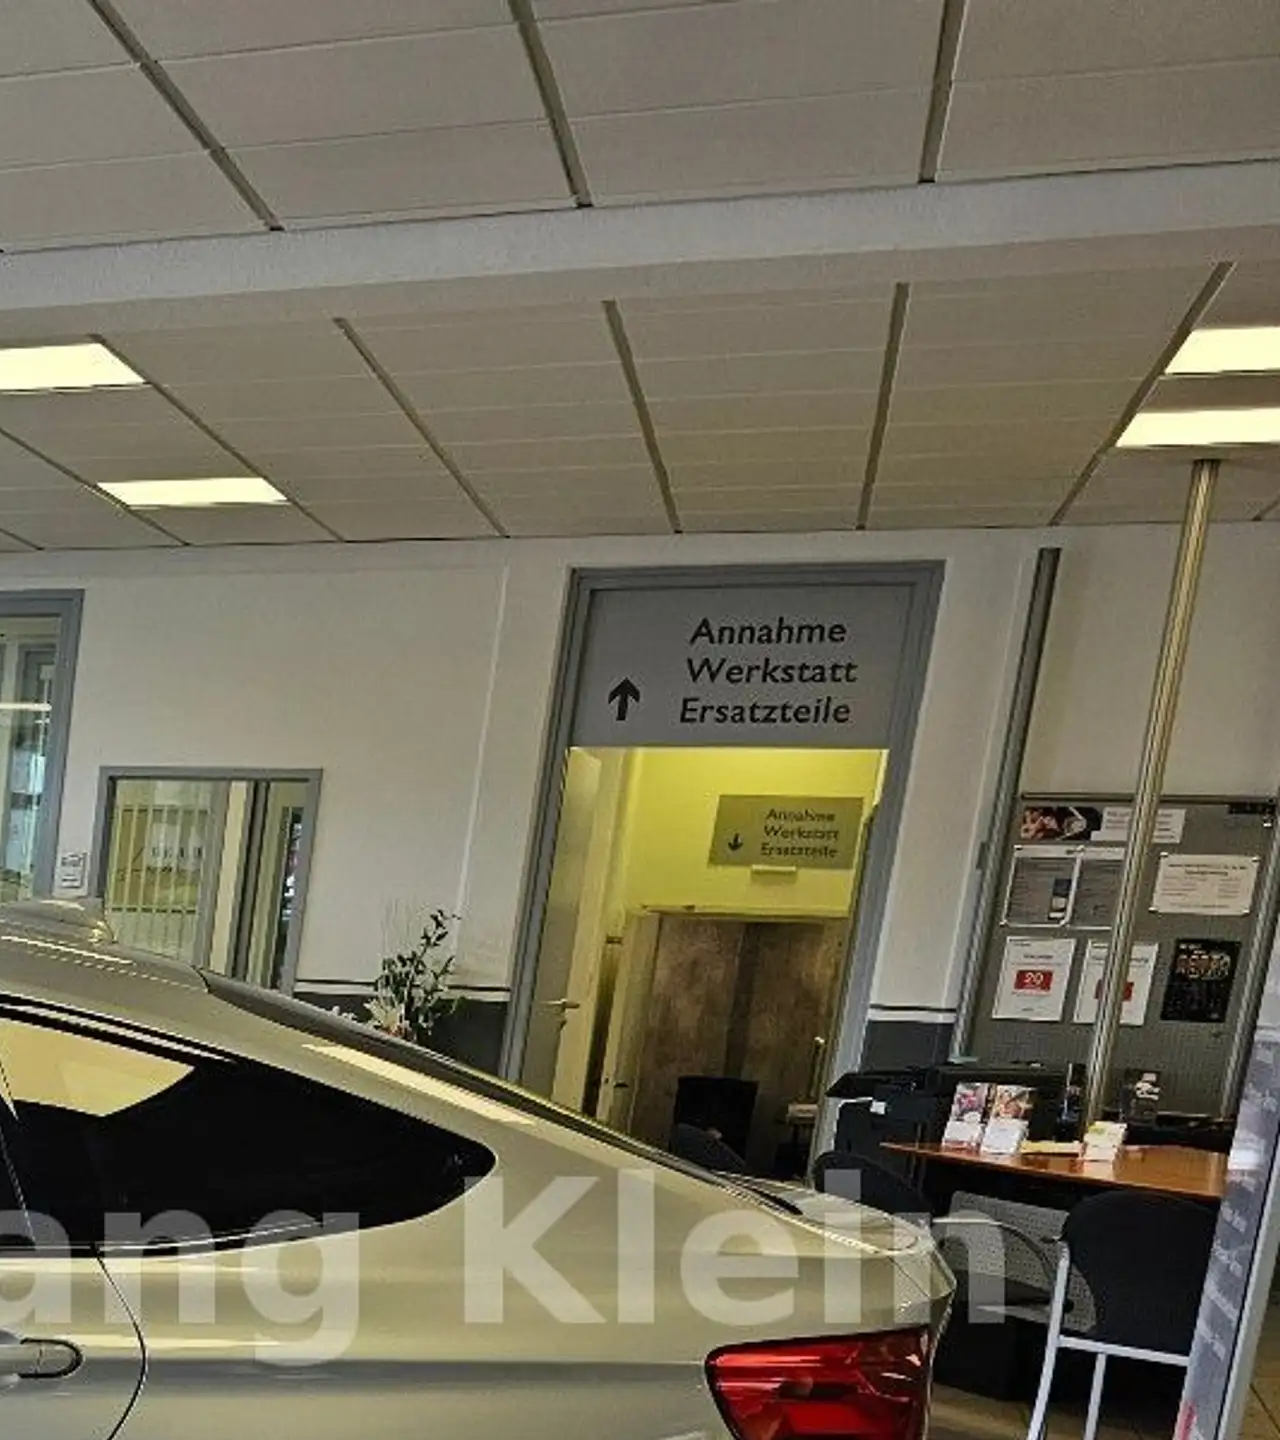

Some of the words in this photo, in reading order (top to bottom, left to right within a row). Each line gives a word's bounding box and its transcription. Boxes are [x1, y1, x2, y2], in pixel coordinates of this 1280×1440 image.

[690, 616, 847, 645] Annahme
[687, 657, 858, 684] Werkstatt
[680, 696, 851, 724] Ersatzteile
[766, 808, 836, 822] Annahme
[763, 825, 840, 841] Werkstatt
[760, 842, 839, 858] Ersatzteile
